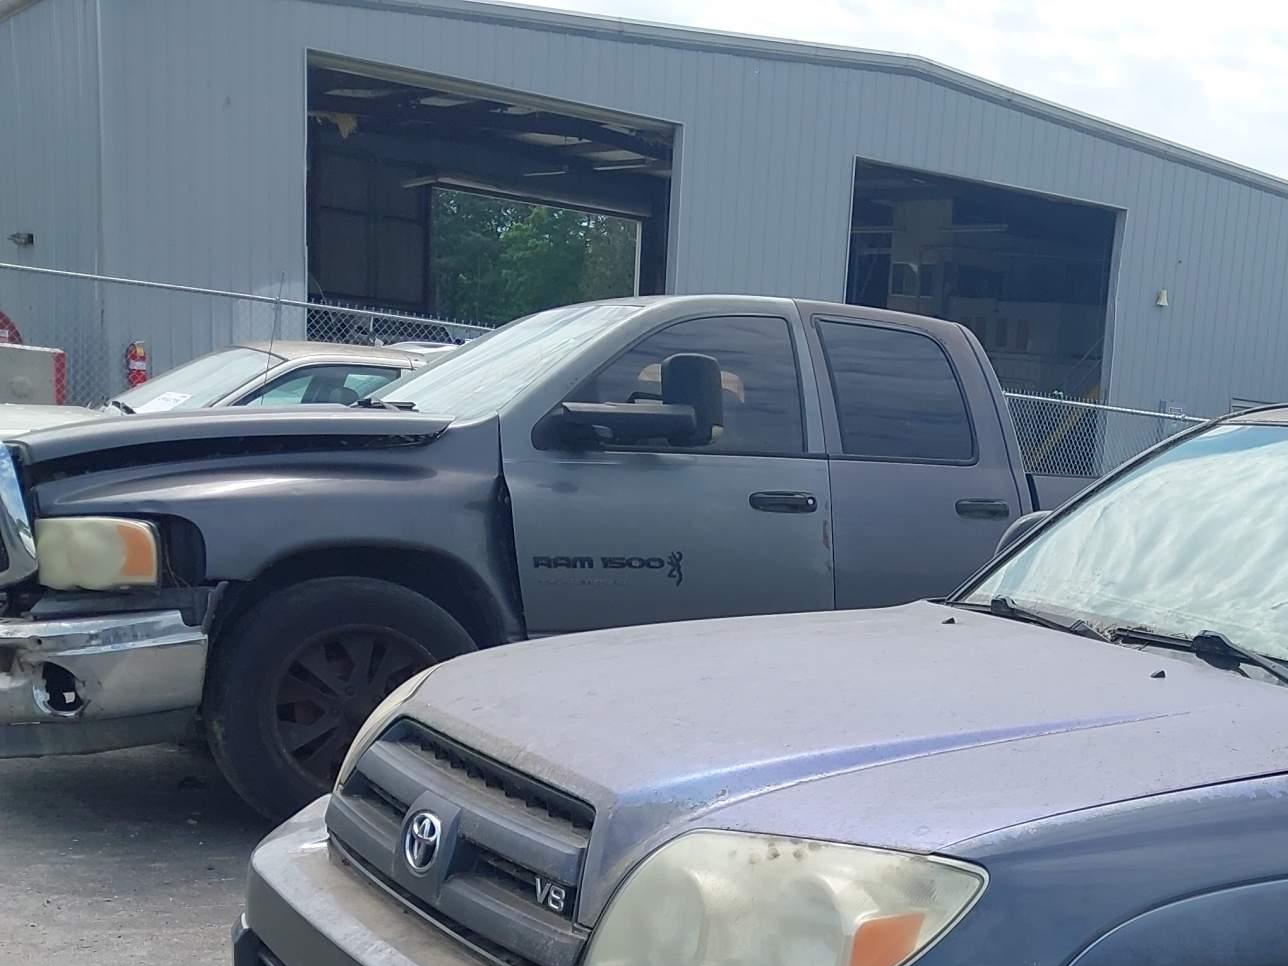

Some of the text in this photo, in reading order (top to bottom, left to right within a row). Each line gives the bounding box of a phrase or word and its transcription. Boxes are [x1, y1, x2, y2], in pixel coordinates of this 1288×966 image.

[532, 556, 665, 569] RAM 1500
[535, 877, 566, 912] V8
